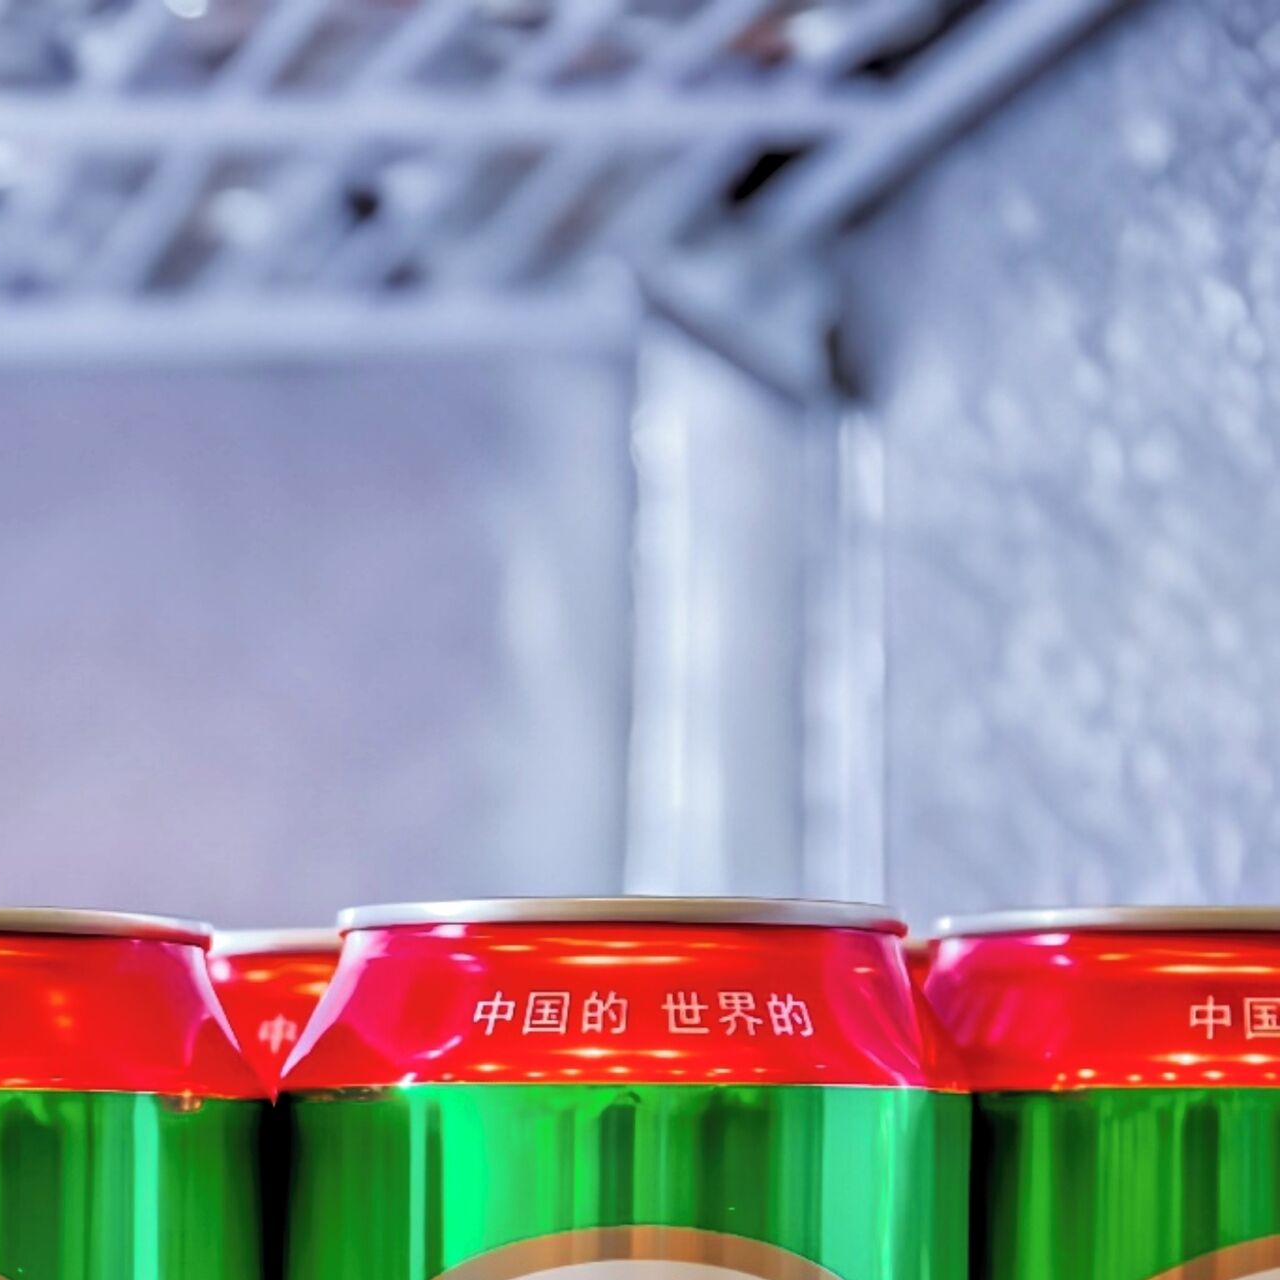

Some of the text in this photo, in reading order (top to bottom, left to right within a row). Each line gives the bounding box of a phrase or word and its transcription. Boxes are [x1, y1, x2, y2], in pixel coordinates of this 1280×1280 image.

[472, 990, 814, 1039] 中国的 世界的
